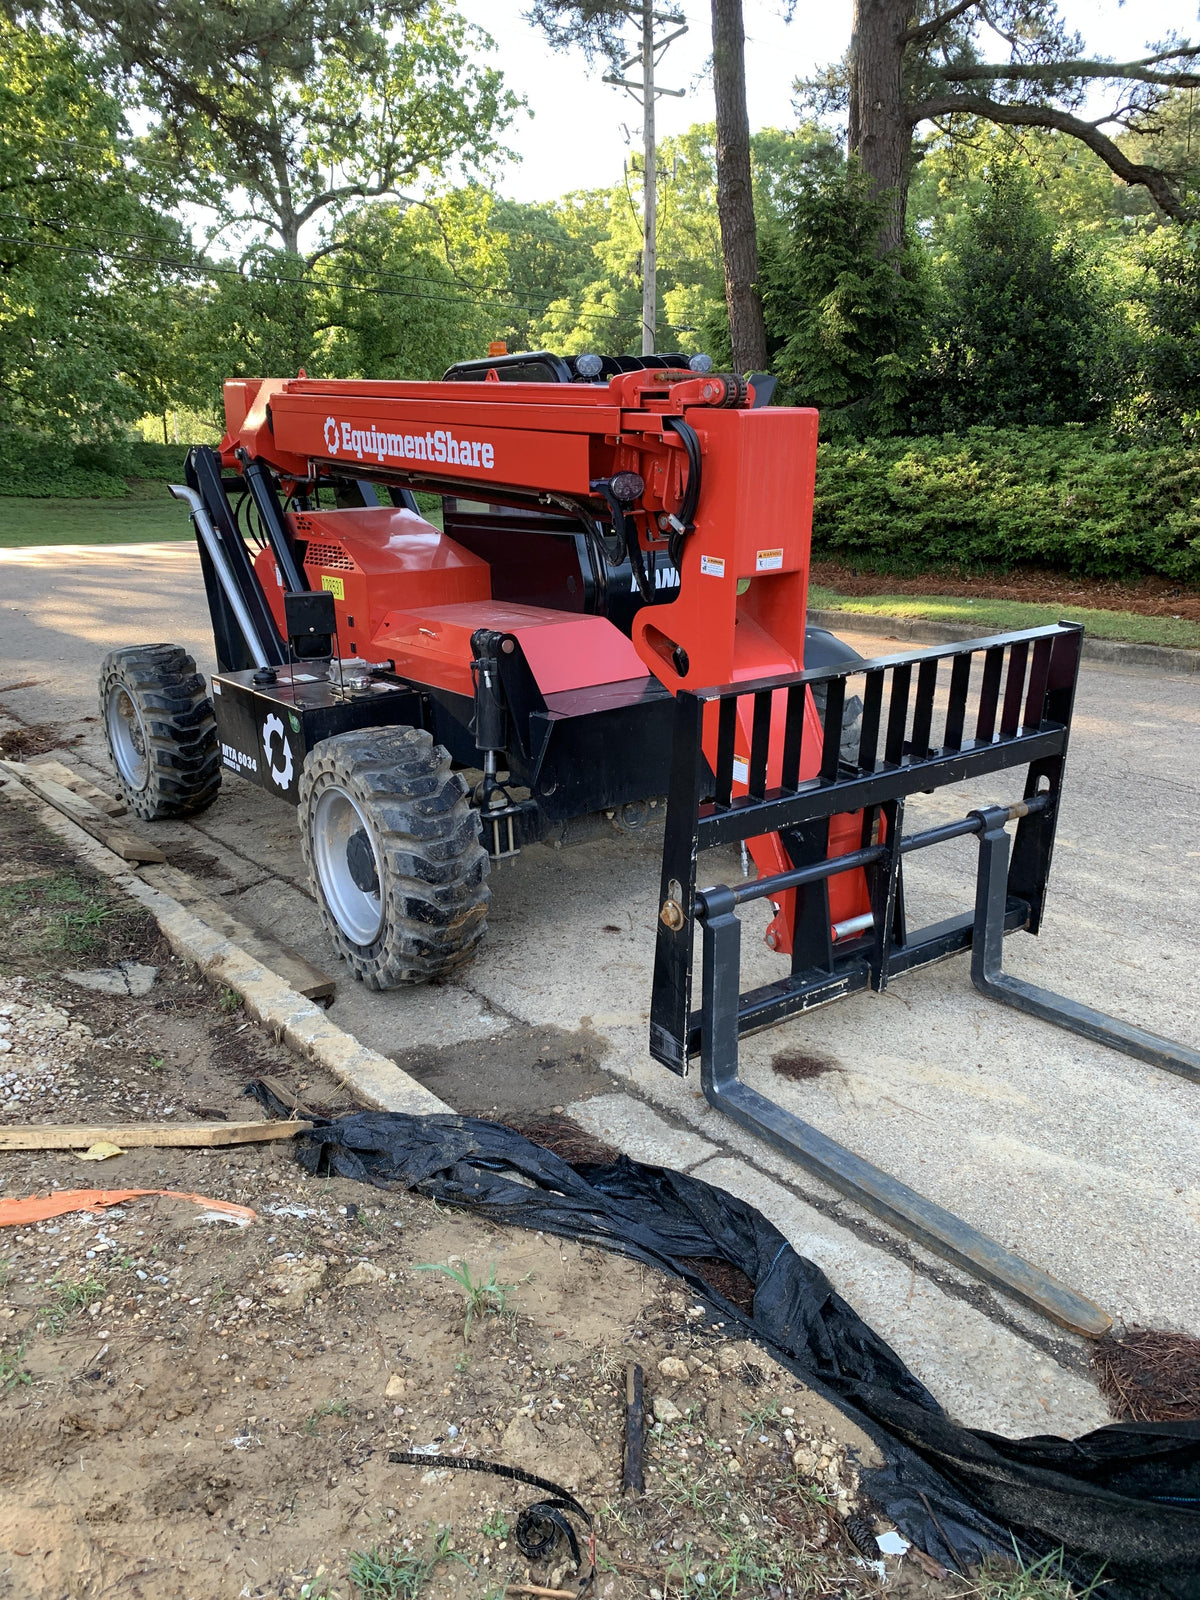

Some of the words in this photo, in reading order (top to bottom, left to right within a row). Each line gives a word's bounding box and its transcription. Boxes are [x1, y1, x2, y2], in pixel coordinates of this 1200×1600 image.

[340, 422, 495, 469] EquipmentShare
[221, 742, 238, 762] MTA
[237, 751, 258, 772] 6034
